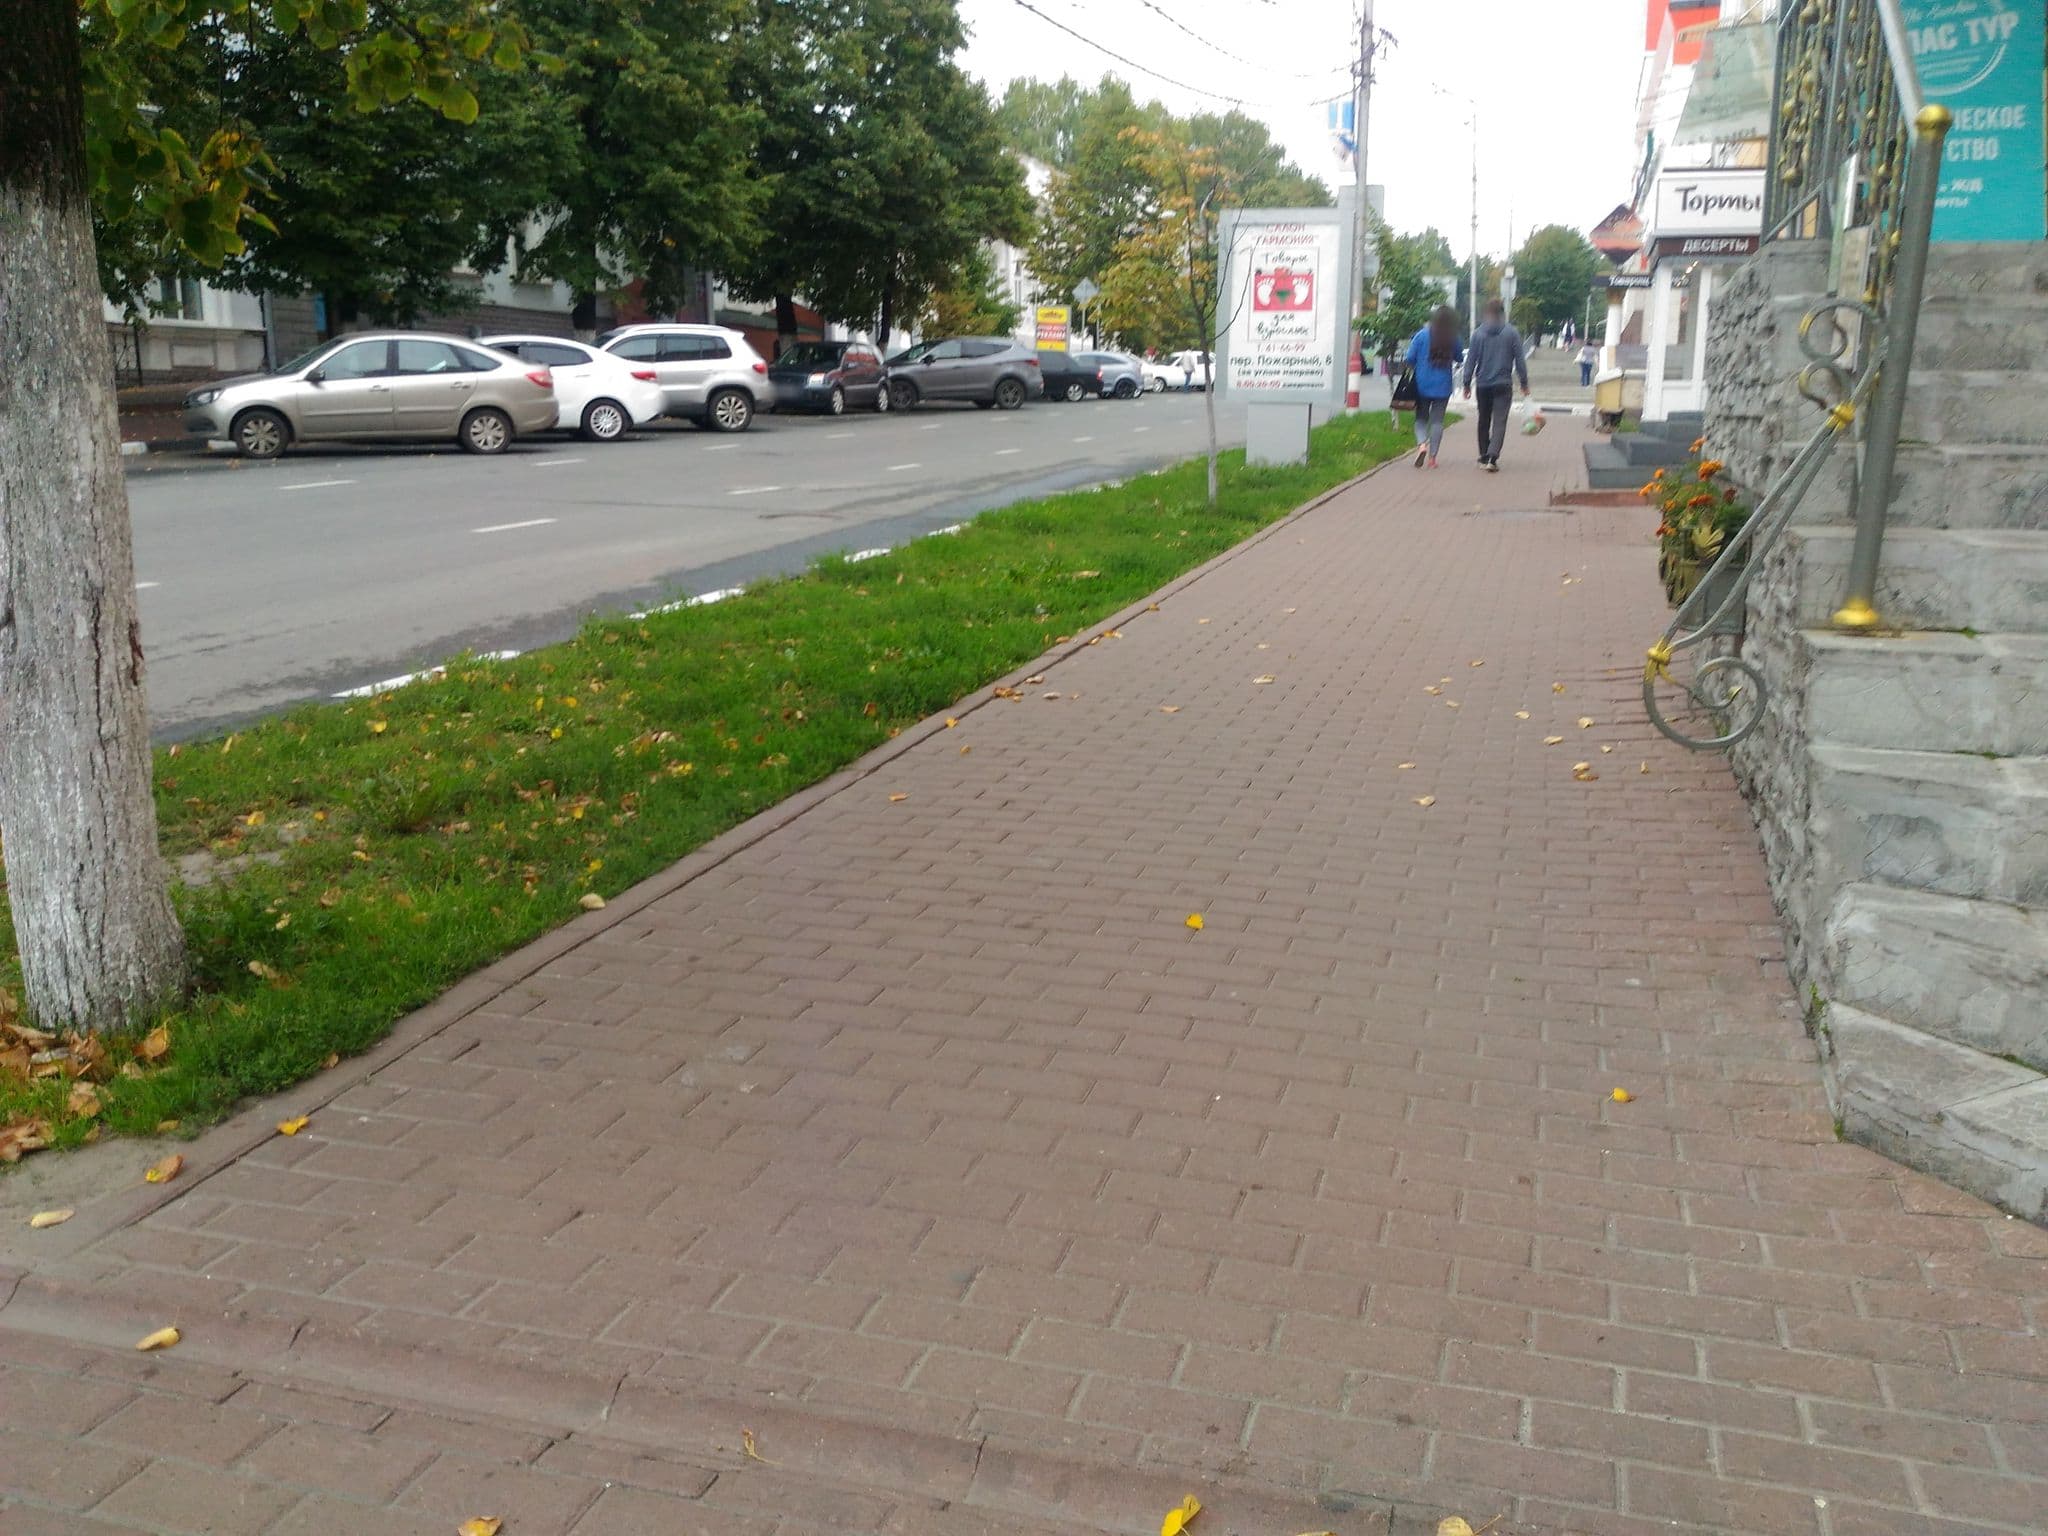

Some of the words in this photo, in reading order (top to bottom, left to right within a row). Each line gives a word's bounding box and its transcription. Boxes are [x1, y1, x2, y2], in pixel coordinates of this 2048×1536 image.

[1964, 11, 2019, 46] ТУР
[1675, 185, 1761, 216] Торты
[1682, 239, 1749, 254] ДЕСЕРТЫ
